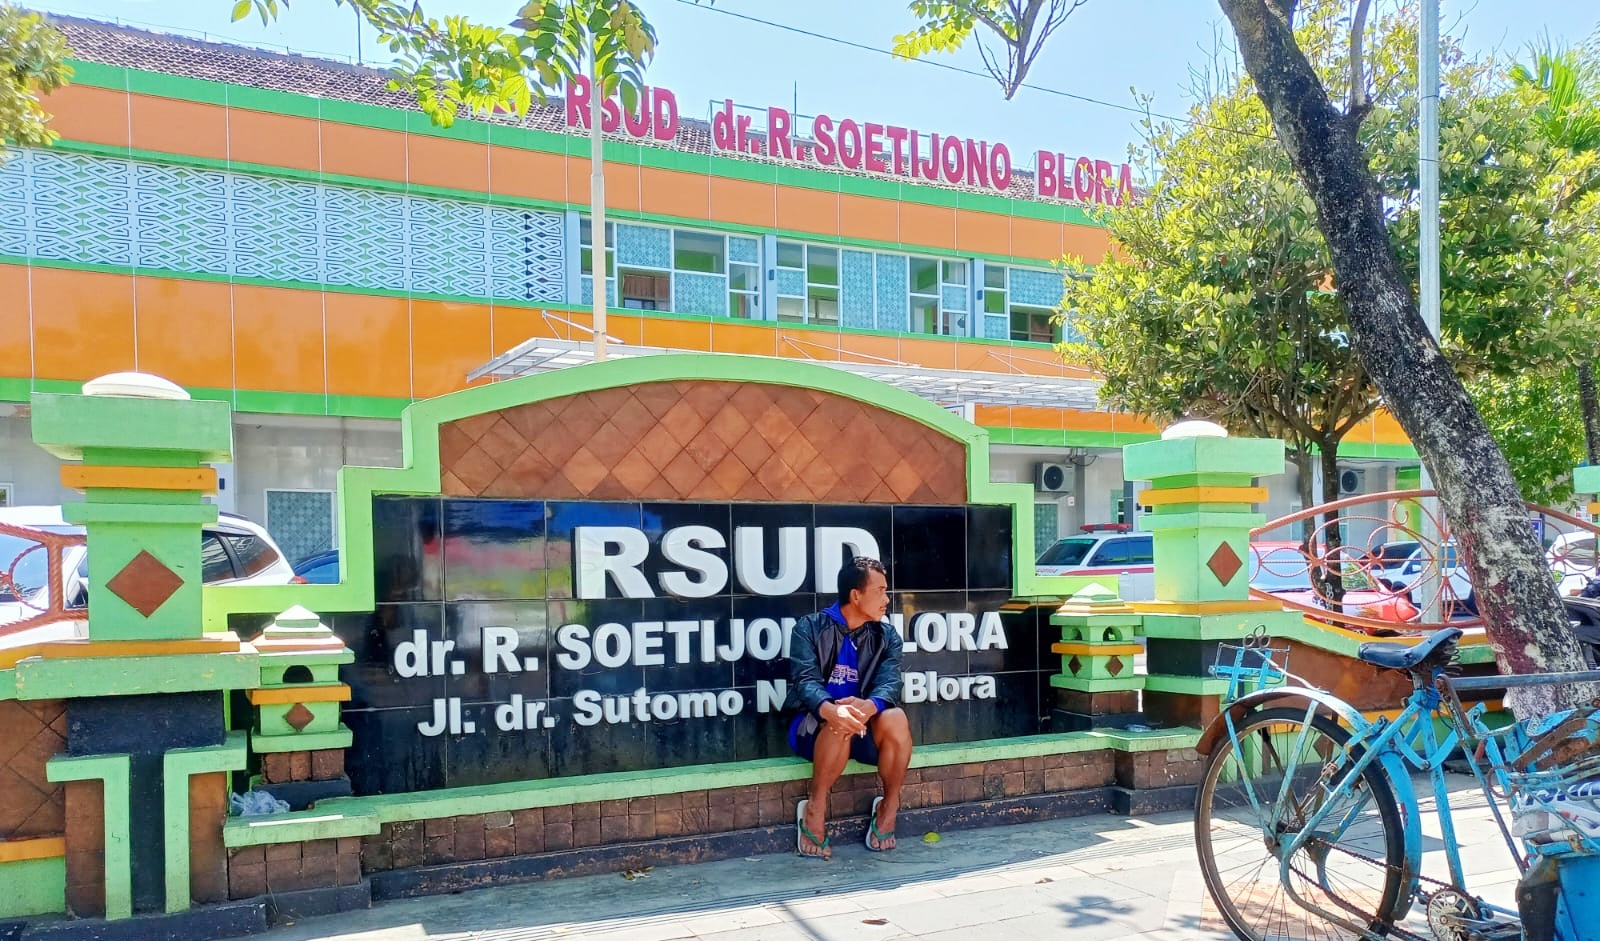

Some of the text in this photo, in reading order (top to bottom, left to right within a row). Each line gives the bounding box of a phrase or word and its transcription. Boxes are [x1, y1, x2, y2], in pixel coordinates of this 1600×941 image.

[567, 74, 1135, 208] RSUD dr. R. SOETIJONO BLORA
[575, 525, 882, 599] RSUD
[394, 611, 1009, 678] dr. R. SOETIJO LORA
[417, 697, 477, 737] Jl.
[494, 694, 555, 731] dr.
[572, 687, 744, 727] Sutomo
[903, 671, 997, 704] Blora
